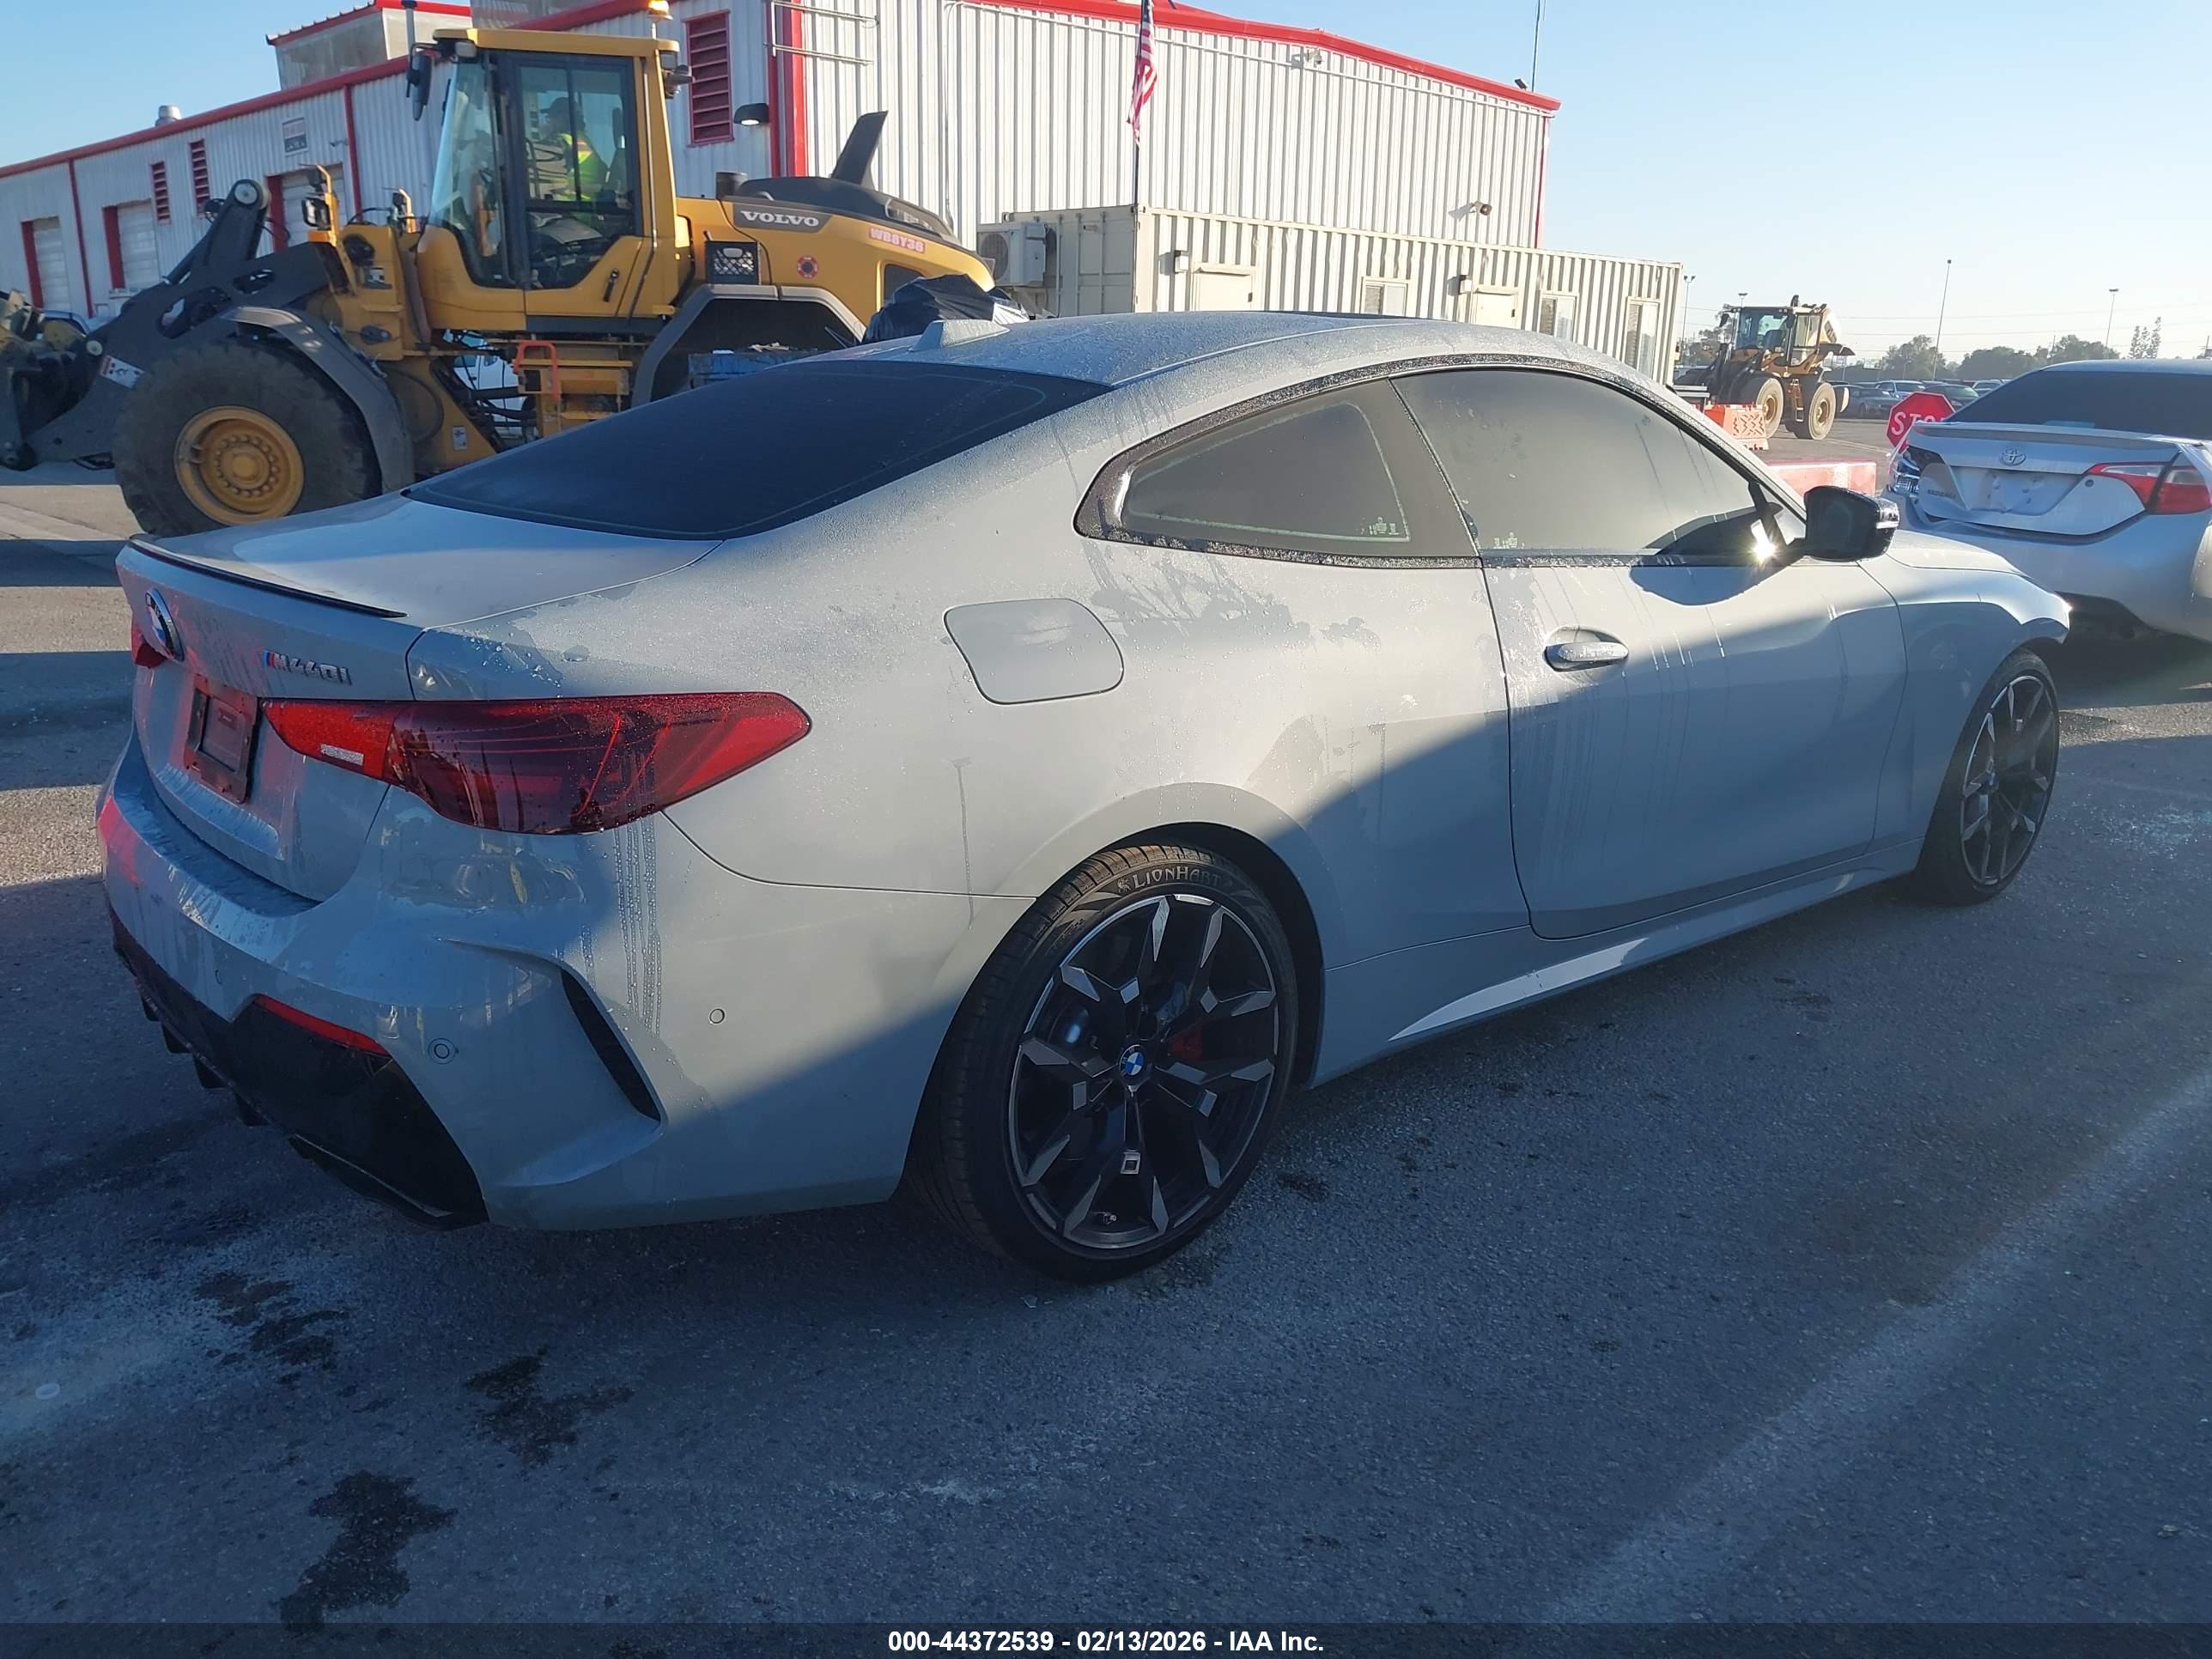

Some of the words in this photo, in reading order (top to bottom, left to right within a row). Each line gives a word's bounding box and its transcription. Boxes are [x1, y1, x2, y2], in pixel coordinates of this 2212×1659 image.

[740, 210, 820, 227] VOLVO
[1891, 411, 1946, 435] ST
[1133, 866, 1222, 890] LIONHART
